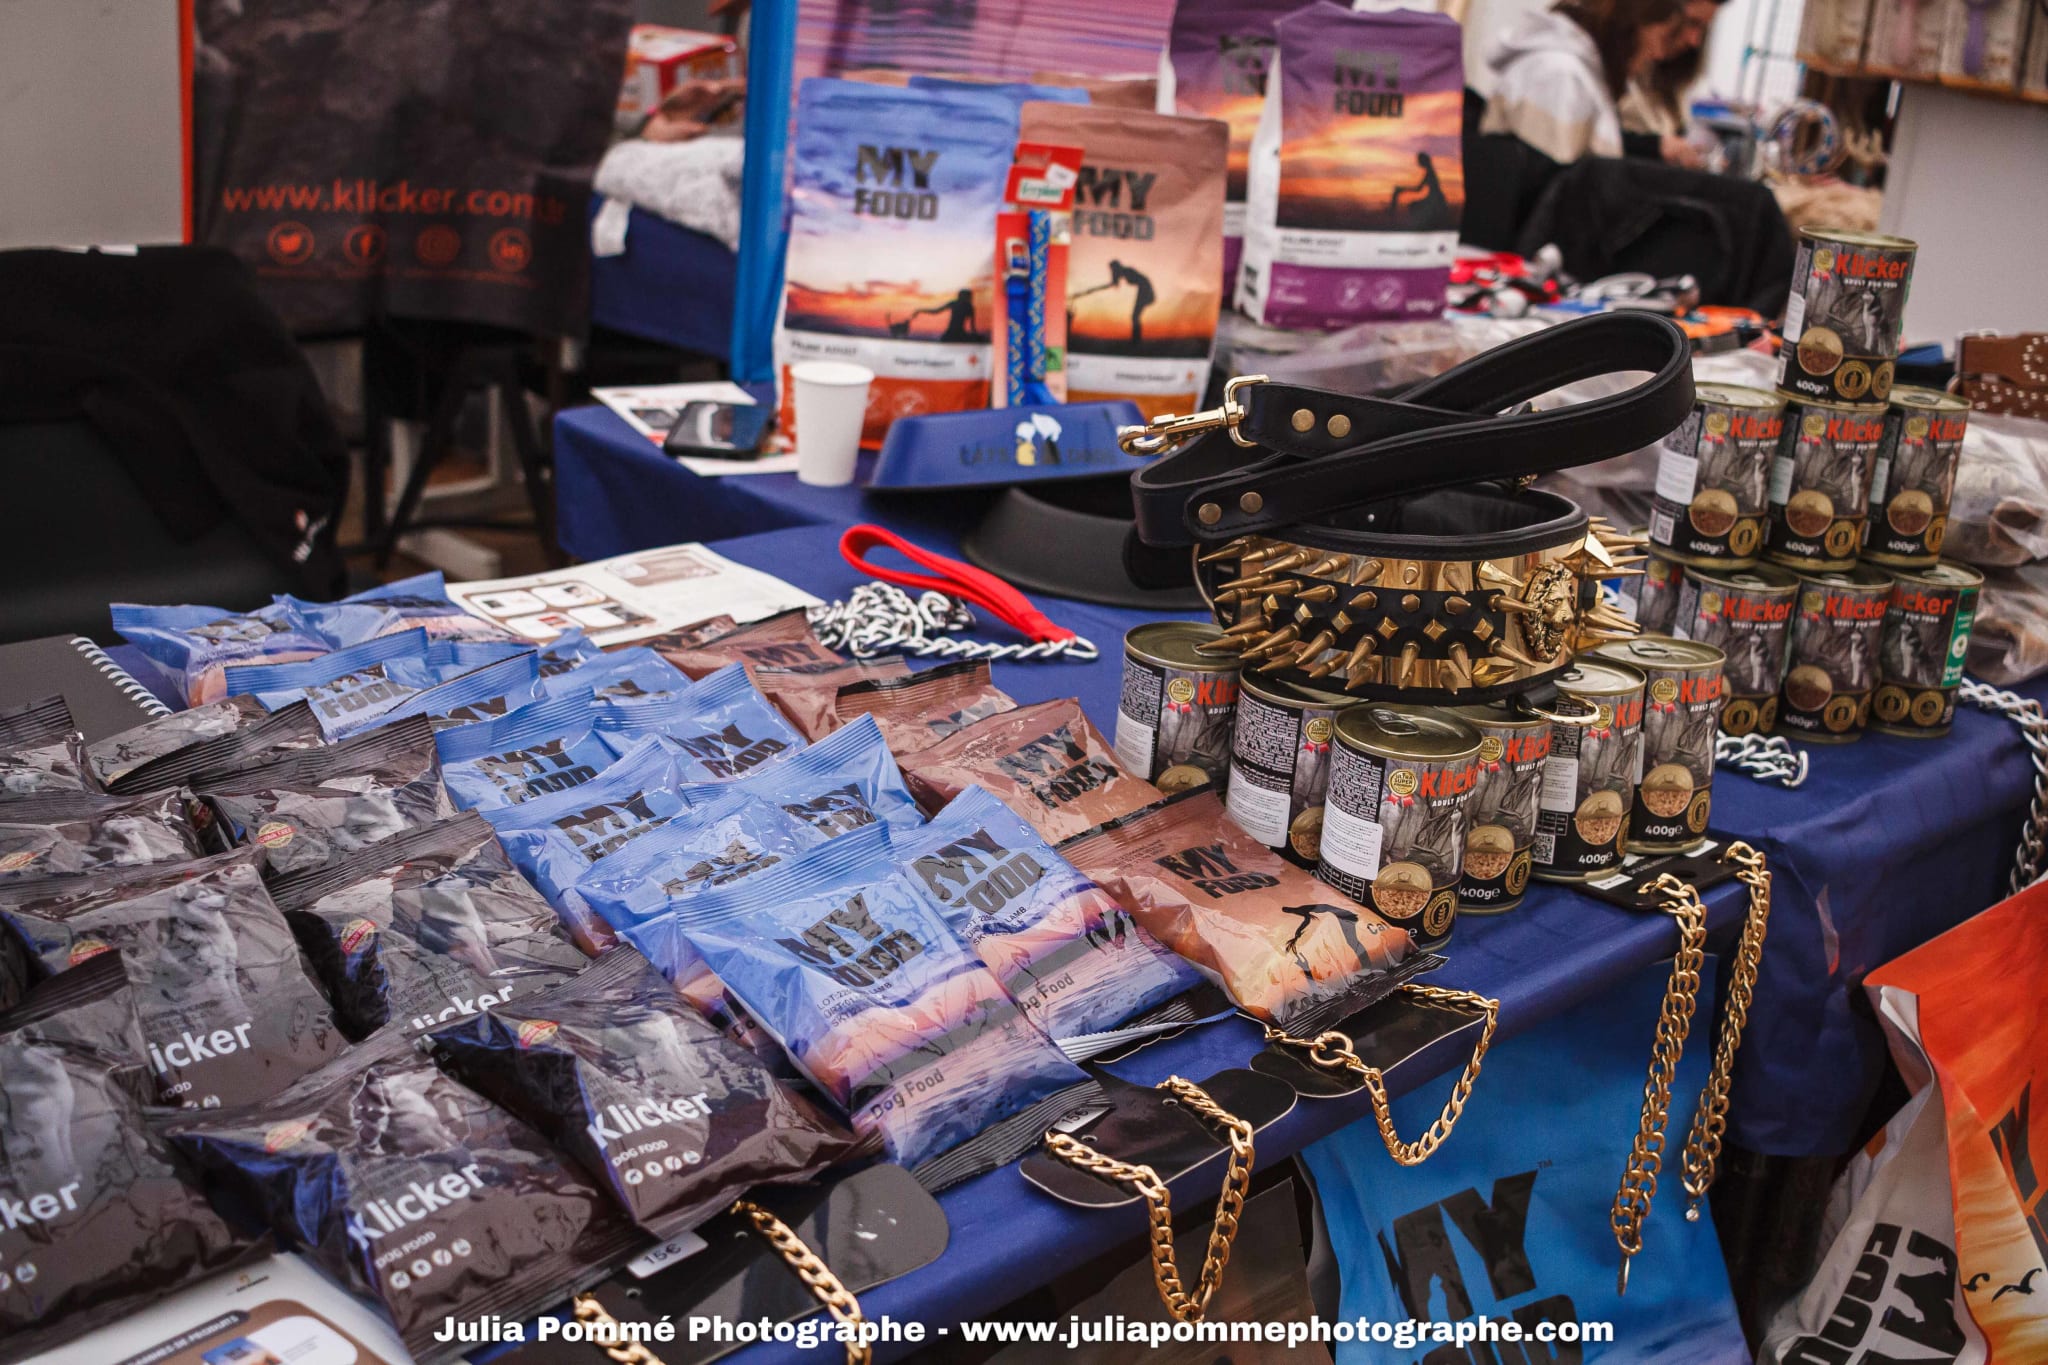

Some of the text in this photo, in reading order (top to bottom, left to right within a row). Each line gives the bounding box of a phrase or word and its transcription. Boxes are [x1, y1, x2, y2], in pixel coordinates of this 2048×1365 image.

[1333, 90, 1405, 118] FOOD
[856, 144, 939, 189] MY
[854, 190, 939, 221] FOOD
[1076, 166, 1157, 211] MY
[1073, 209, 1155, 240] FOOD
[1835, 253, 1908, 280] Klicker
[1723, 597, 1792, 622] Klicker
[667, 723, 754, 758] MY
[994, 723, 1087, 787] MY
[474, 738, 574, 786] MY
[552, 790, 656, 848] MY
[1432, 798, 1454, 807] ADULT
[912, 828, 1010, 903] MY
[1153, 843, 1238, 881] MY
[950, 852, 1046, 915] OOD
[1191, 872, 1281, 899] FOOD
[774, 892, 884, 967] MY
[1005, 906, 1027, 923] LAMB
[1020, 972, 1075, 1013] og Food
[869, 1068, 945, 1122] Dog Food
[587, 1091, 712, 1150] Klicker
[612, 1139, 669, 1168] DOG FOOD
[0, 1182, 80, 1234] ker
[347, 1163, 485, 1251] Klicker
[374, 1231, 437, 1269] DOG FOOD
[644, 1243, 682, 1265] 15€
[1376, 1170, 1539, 1337] MY
